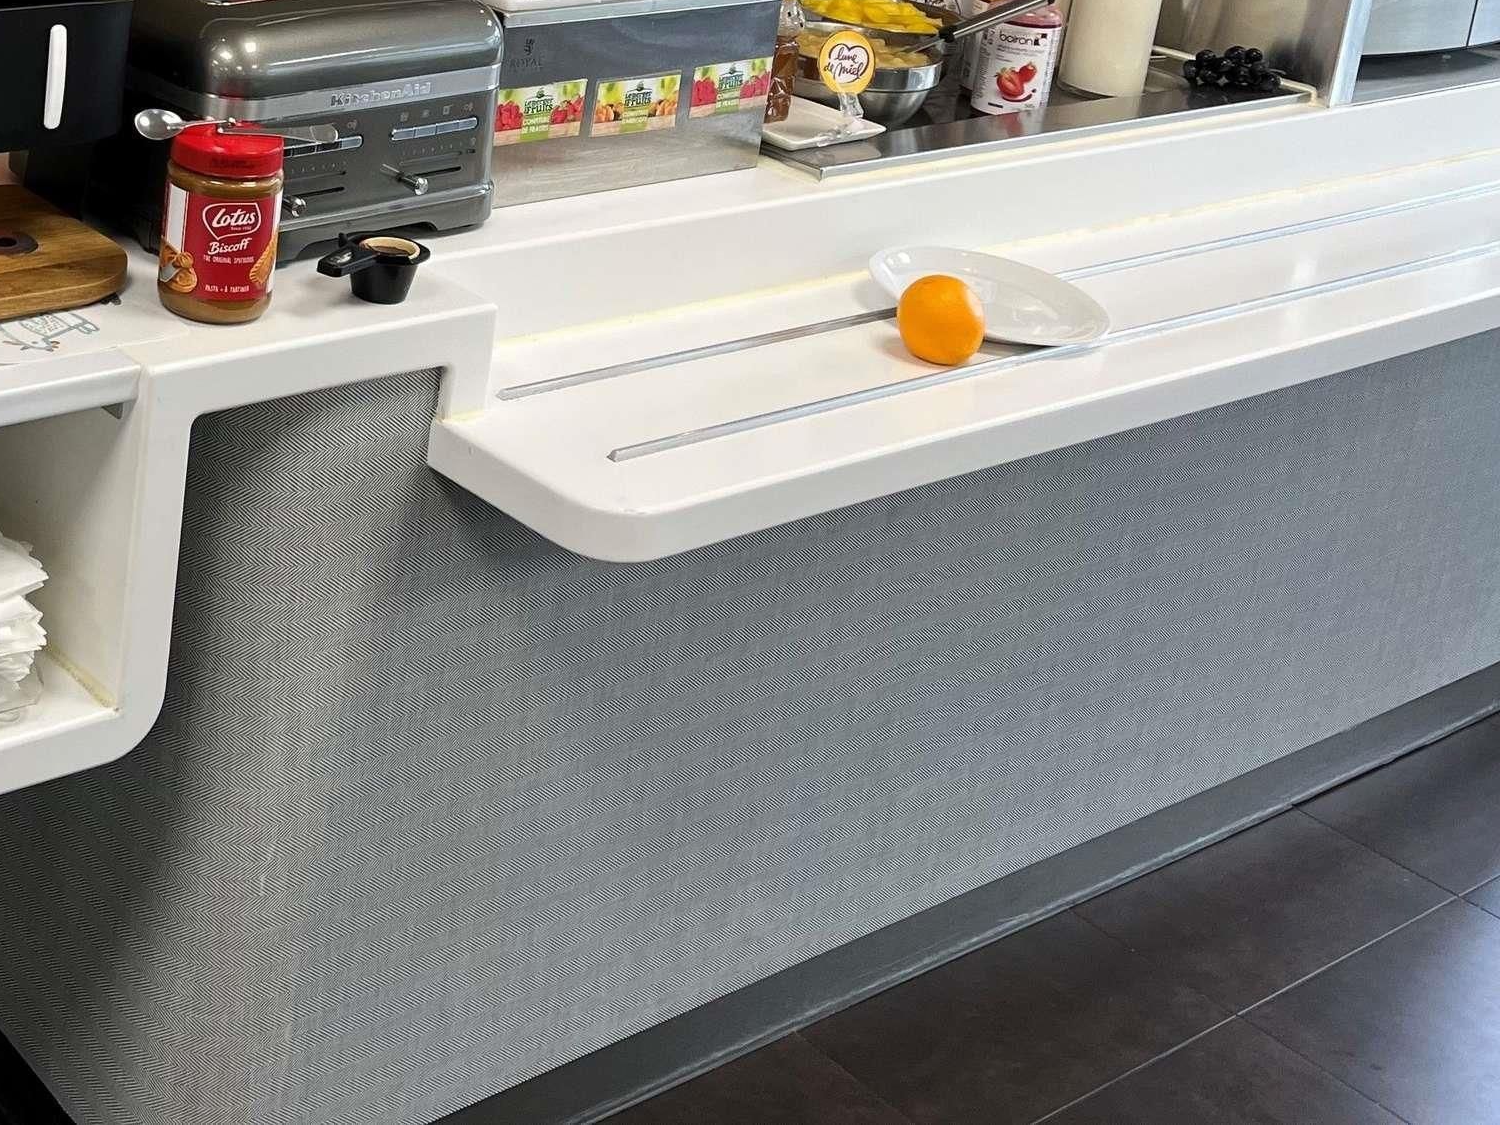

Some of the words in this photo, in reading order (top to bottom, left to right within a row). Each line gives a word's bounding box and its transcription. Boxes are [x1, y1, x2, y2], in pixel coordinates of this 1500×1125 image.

[330, 81, 432, 108] KitchenAid
[211, 207, 256, 228] Lotus
[207, 237, 253, 254] Biscoff
